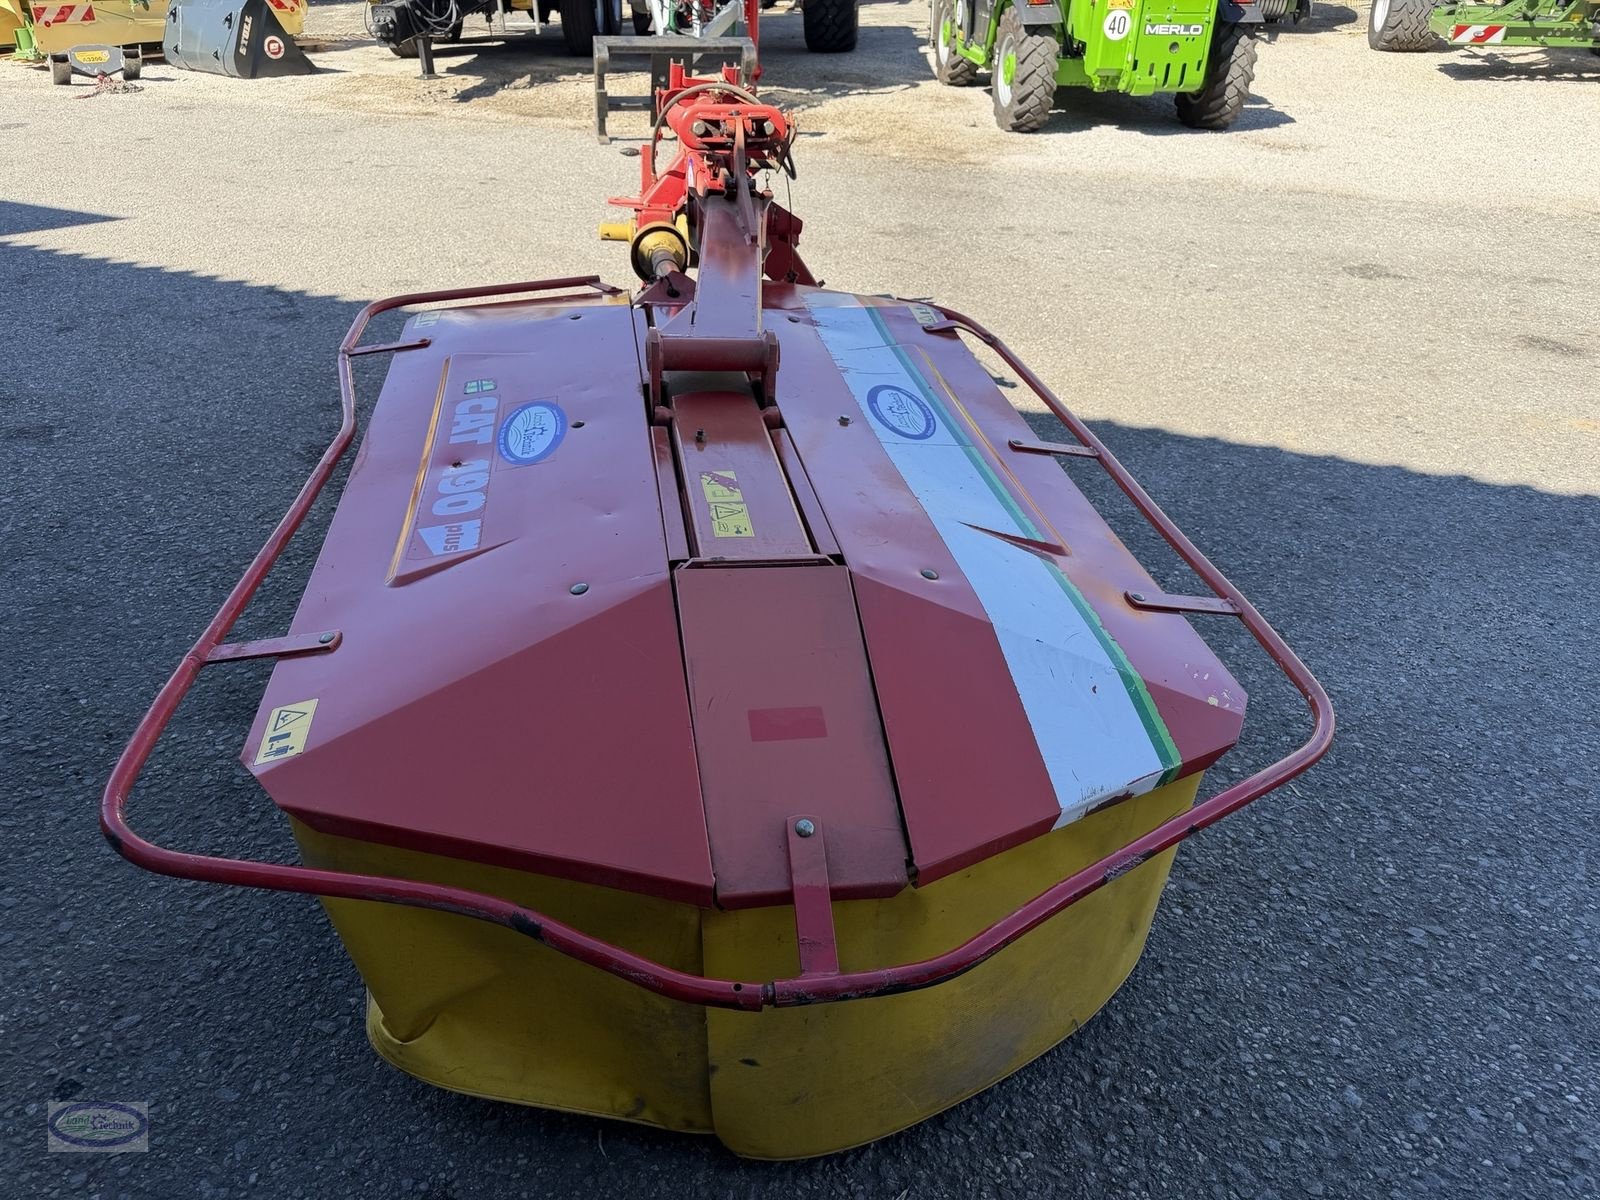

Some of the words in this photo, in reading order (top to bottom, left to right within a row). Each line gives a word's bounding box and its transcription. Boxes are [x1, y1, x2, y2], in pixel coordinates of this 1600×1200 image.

[1108, 15, 1127, 35] 40
[1145, 24, 1203, 35] MERLO
[449, 397, 498, 444] CAT
[432, 459, 490, 516] 190
[443, 525, 464, 552] plus
